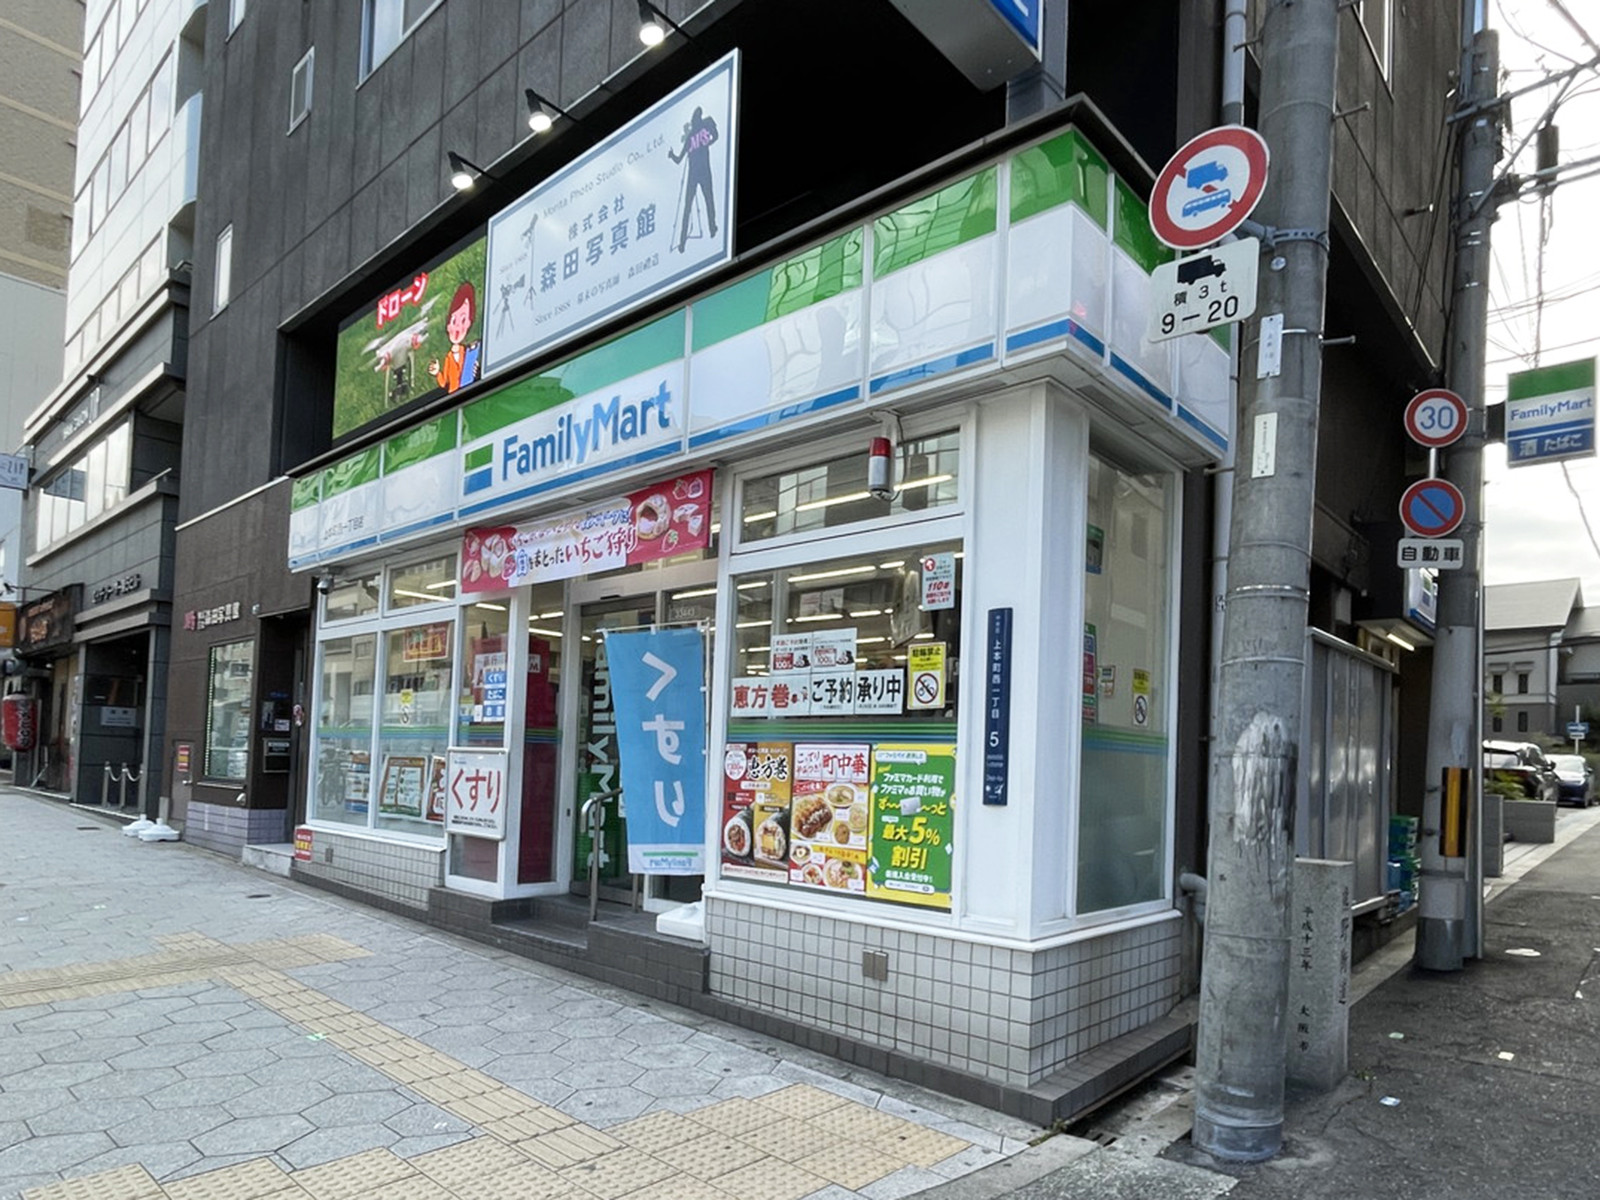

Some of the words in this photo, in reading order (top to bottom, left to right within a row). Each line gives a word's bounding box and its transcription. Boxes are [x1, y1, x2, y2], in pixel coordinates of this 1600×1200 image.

[570, 182, 594, 203] Photo
[595, 162, 624, 186] Studio
[568, 195, 624, 241] 株式会社
[540, 203, 656, 292] 森田写真館
[377, 274, 427, 328] ドローン
[1420, 406, 1454, 430] 30
[1510, 397, 1591, 421] FamilyMart
[502, 380, 672, 482] FamilyMart
[1520, 438, 1537, 456] 酒
[1544, 434, 1583, 453] たばこ
[1402, 546, 1460, 562] 自動車
[989, 731, 999, 747] 5
[823, 752, 867, 777] 町中華
[451, 768, 501, 814] くすり
[891, 845, 928, 870] 割引
